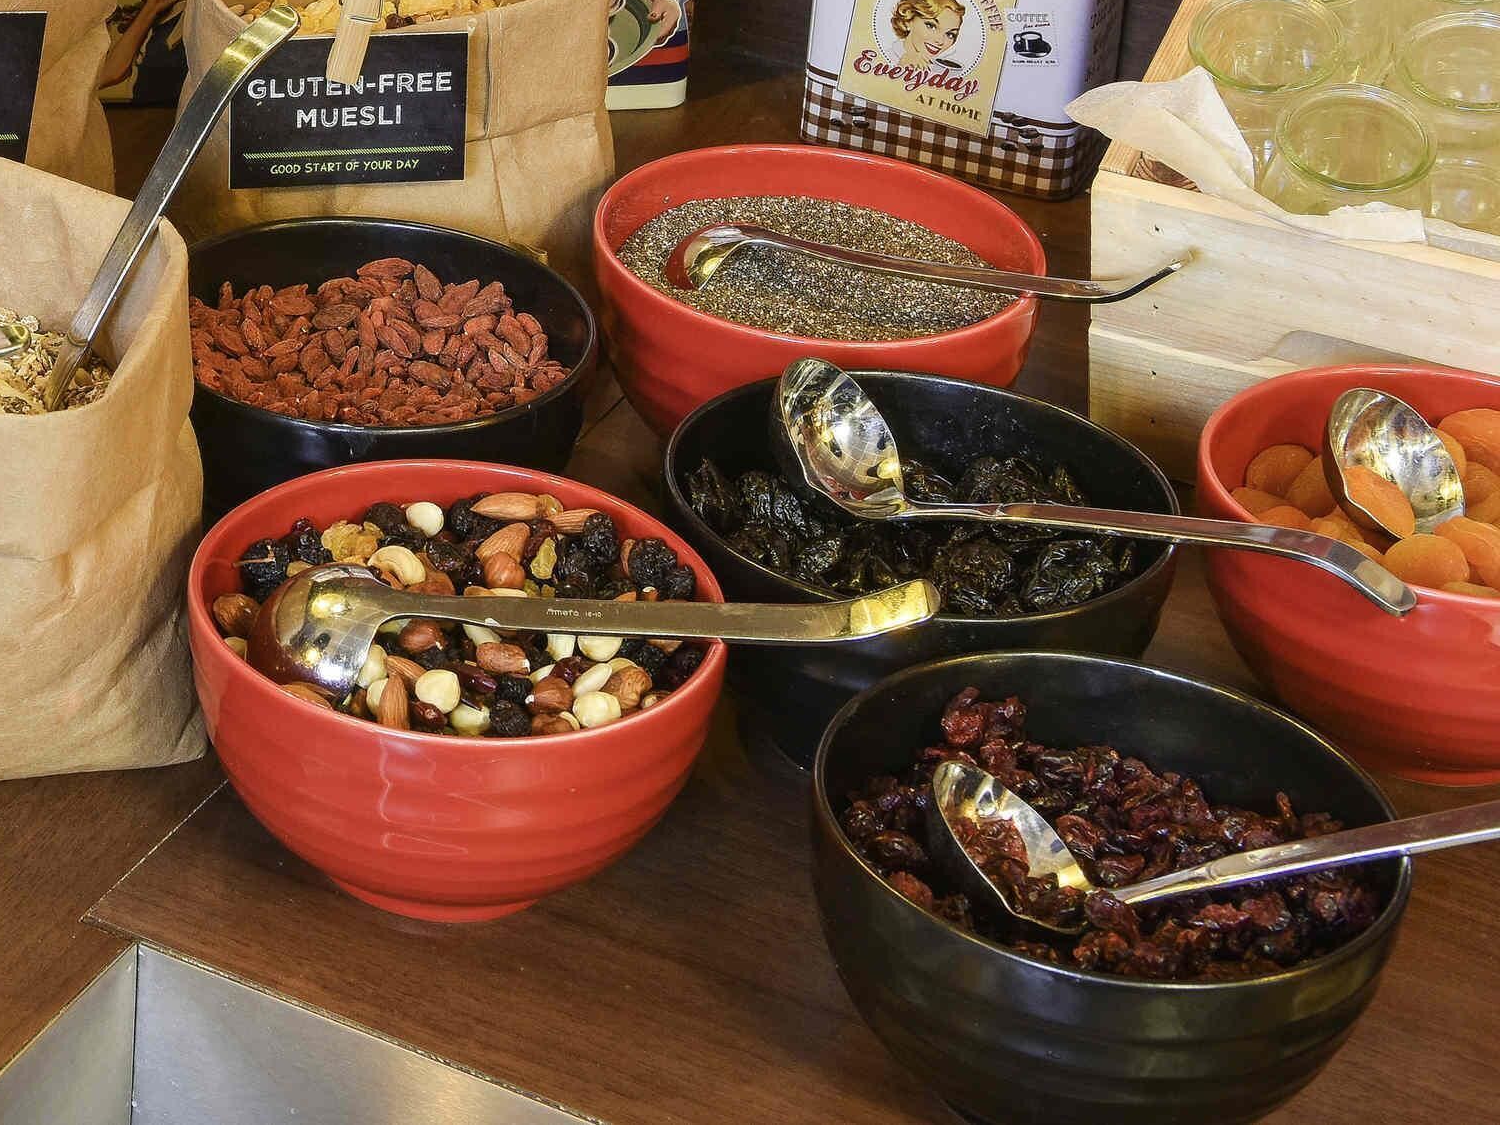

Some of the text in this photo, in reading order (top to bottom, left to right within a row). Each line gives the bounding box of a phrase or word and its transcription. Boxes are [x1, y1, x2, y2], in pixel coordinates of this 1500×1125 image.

[247, 71, 453, 100] GLUTEN-FREE
[853, 50, 980, 102] Everyday
[296, 104, 402, 129] MUESLI
[916, 93, 983, 122] AT HOME
[270, 159, 419, 175] GOOD START OF YOUR DAY
